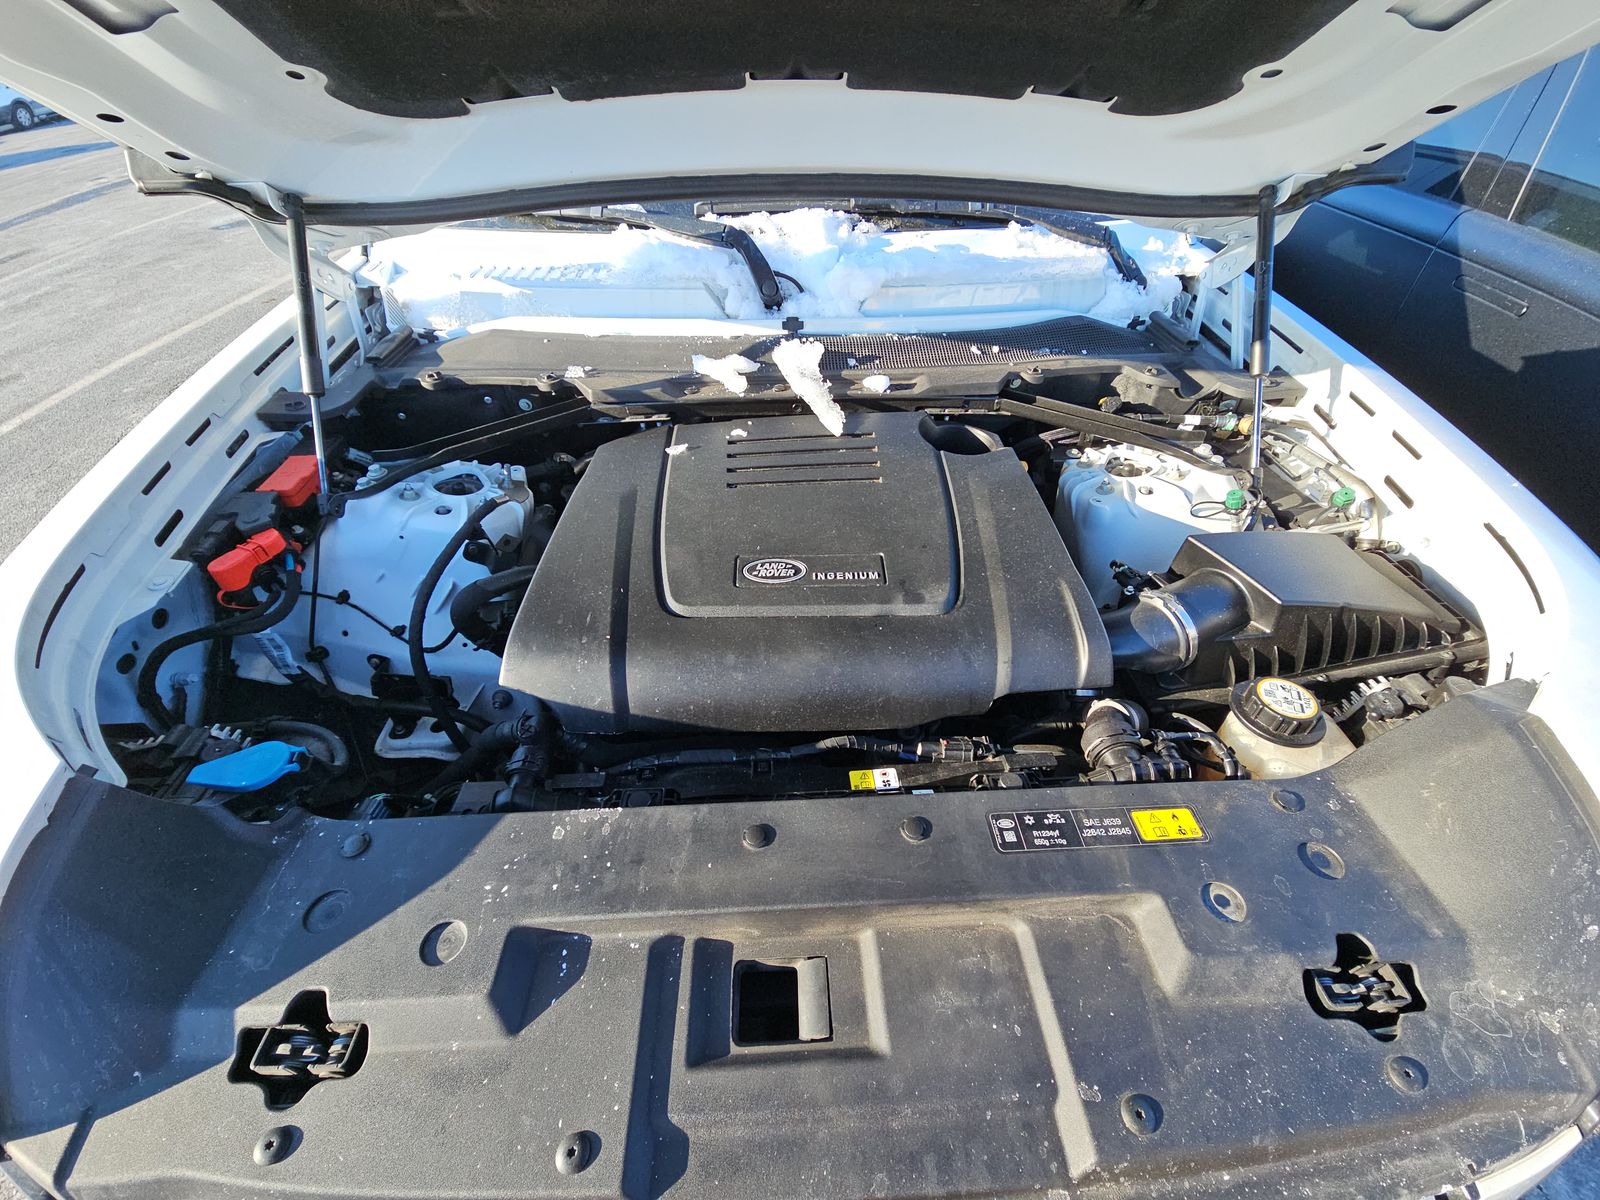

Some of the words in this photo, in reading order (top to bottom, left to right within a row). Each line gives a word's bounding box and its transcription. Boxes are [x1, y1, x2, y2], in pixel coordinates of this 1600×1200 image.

[756, 562, 787, 570] LAND
[758, 568, 795, 577] ROVER
[812, 571, 879, 581] INGENIUM
[1083, 819, 1101, 827] SAE
[1102, 818, 1122, 826] J639
[1032, 829, 1060, 838] R1234yf
[1082, 828, 1107, 837] J2842
[1107, 827, 1132, 835] J2845
[1034, 838, 1049, 846] 650g
